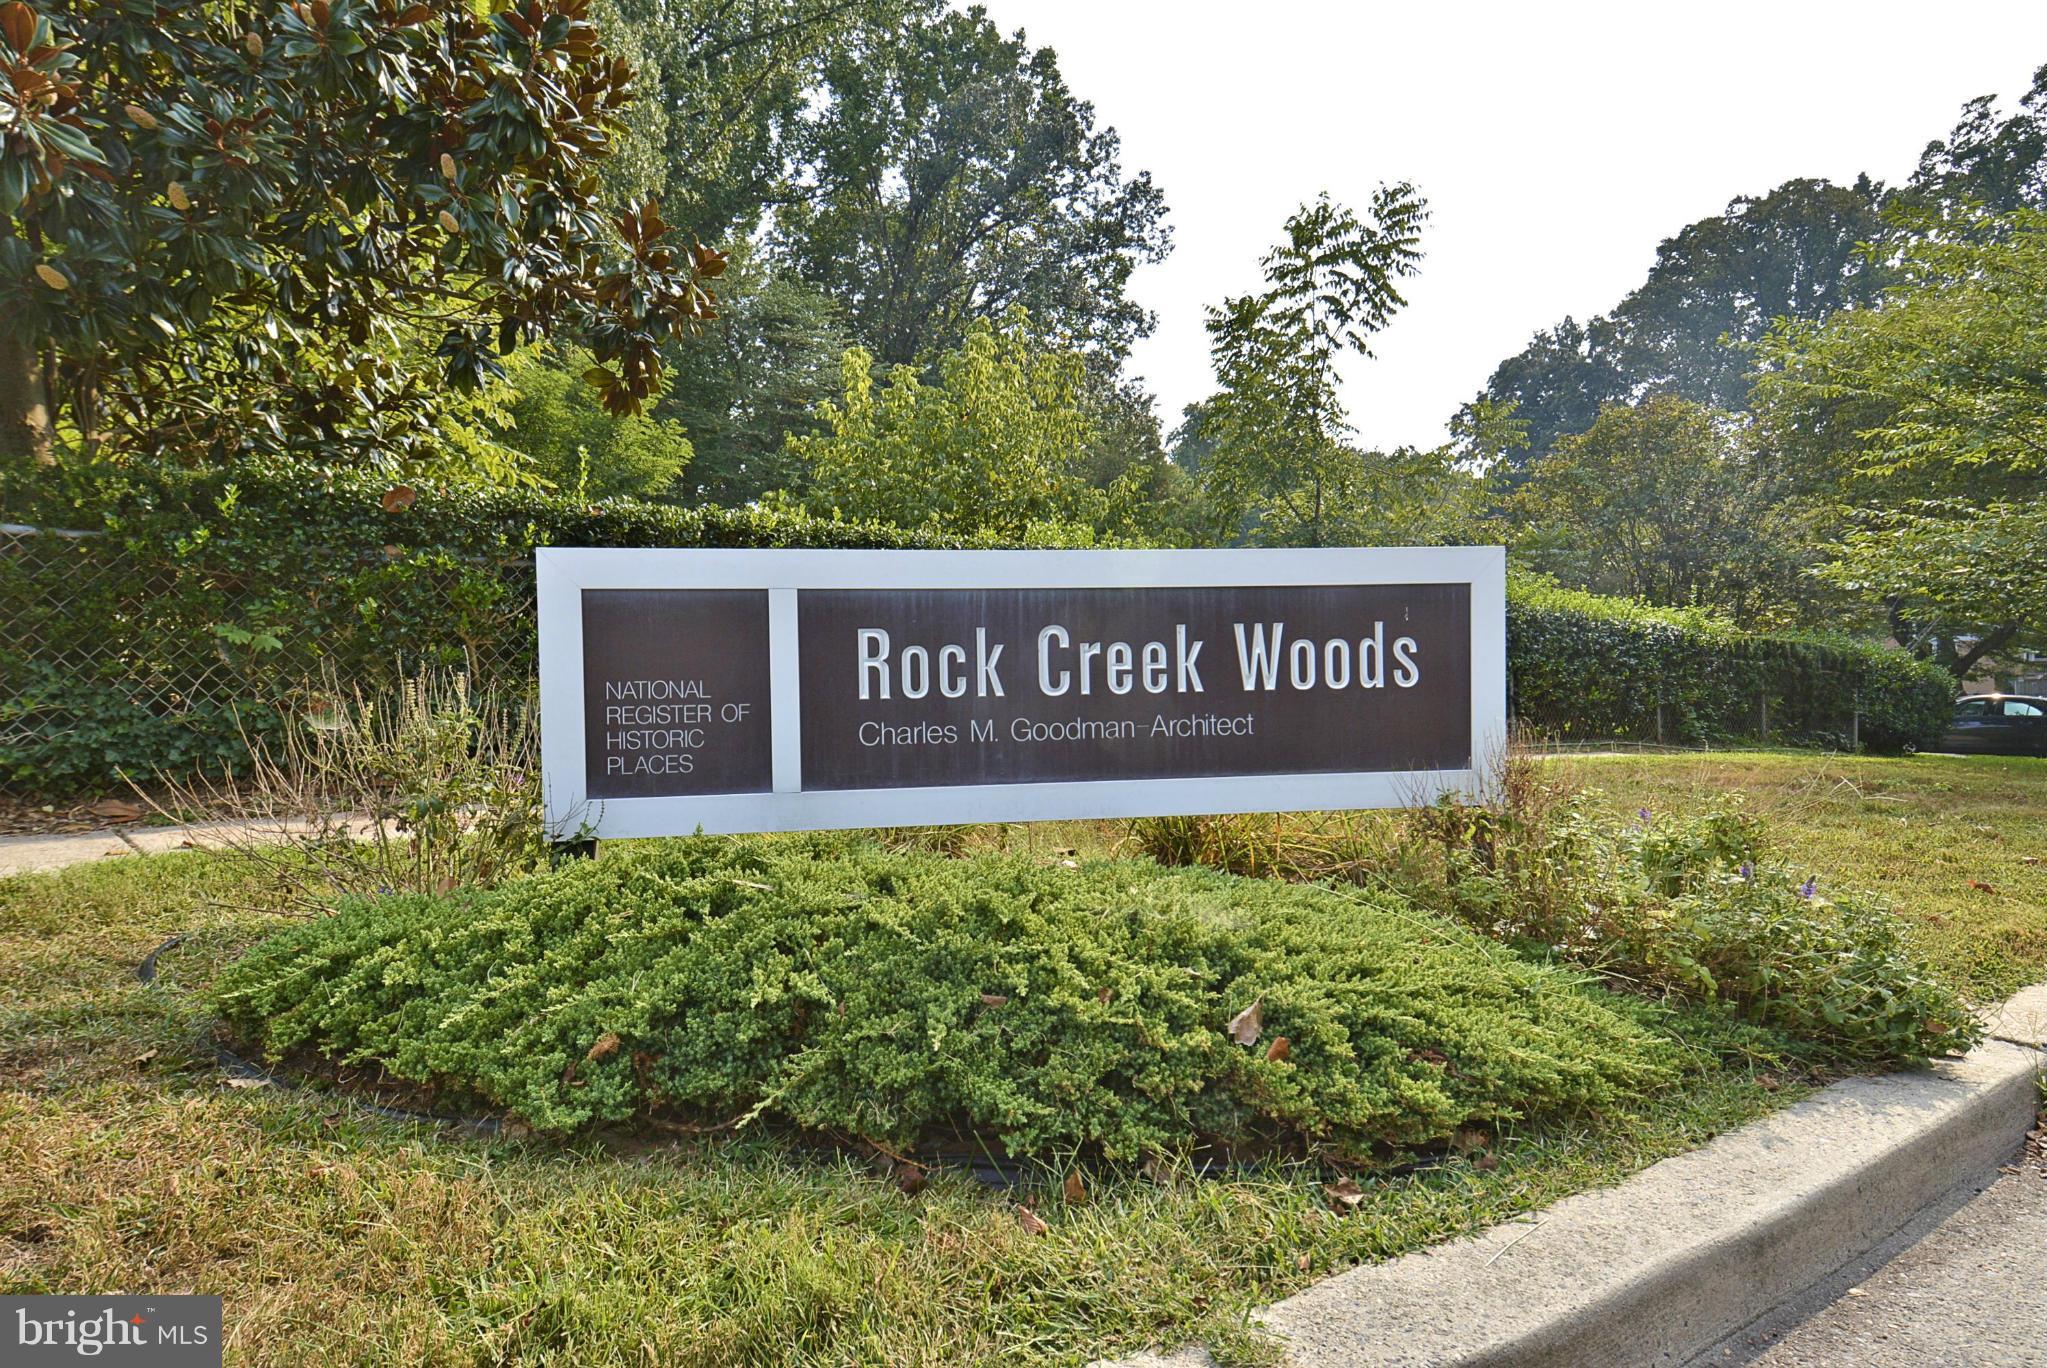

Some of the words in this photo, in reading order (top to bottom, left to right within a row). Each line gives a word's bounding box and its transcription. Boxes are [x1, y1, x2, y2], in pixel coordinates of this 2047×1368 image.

[857, 626, 1006, 700] Rock
[1037, 623, 1205, 697] Creek
[1233, 620, 1420, 692] Woods
[605, 680, 712, 700] NATIONAL
[606, 704, 712, 726] REGISTER
[721, 703, 751, 723] OF
[606, 728, 705, 751] HISTORIC
[858, 720, 958, 747] Charles
[970, 719, 999, 743] M.
[607, 754, 694, 776] PLACES
